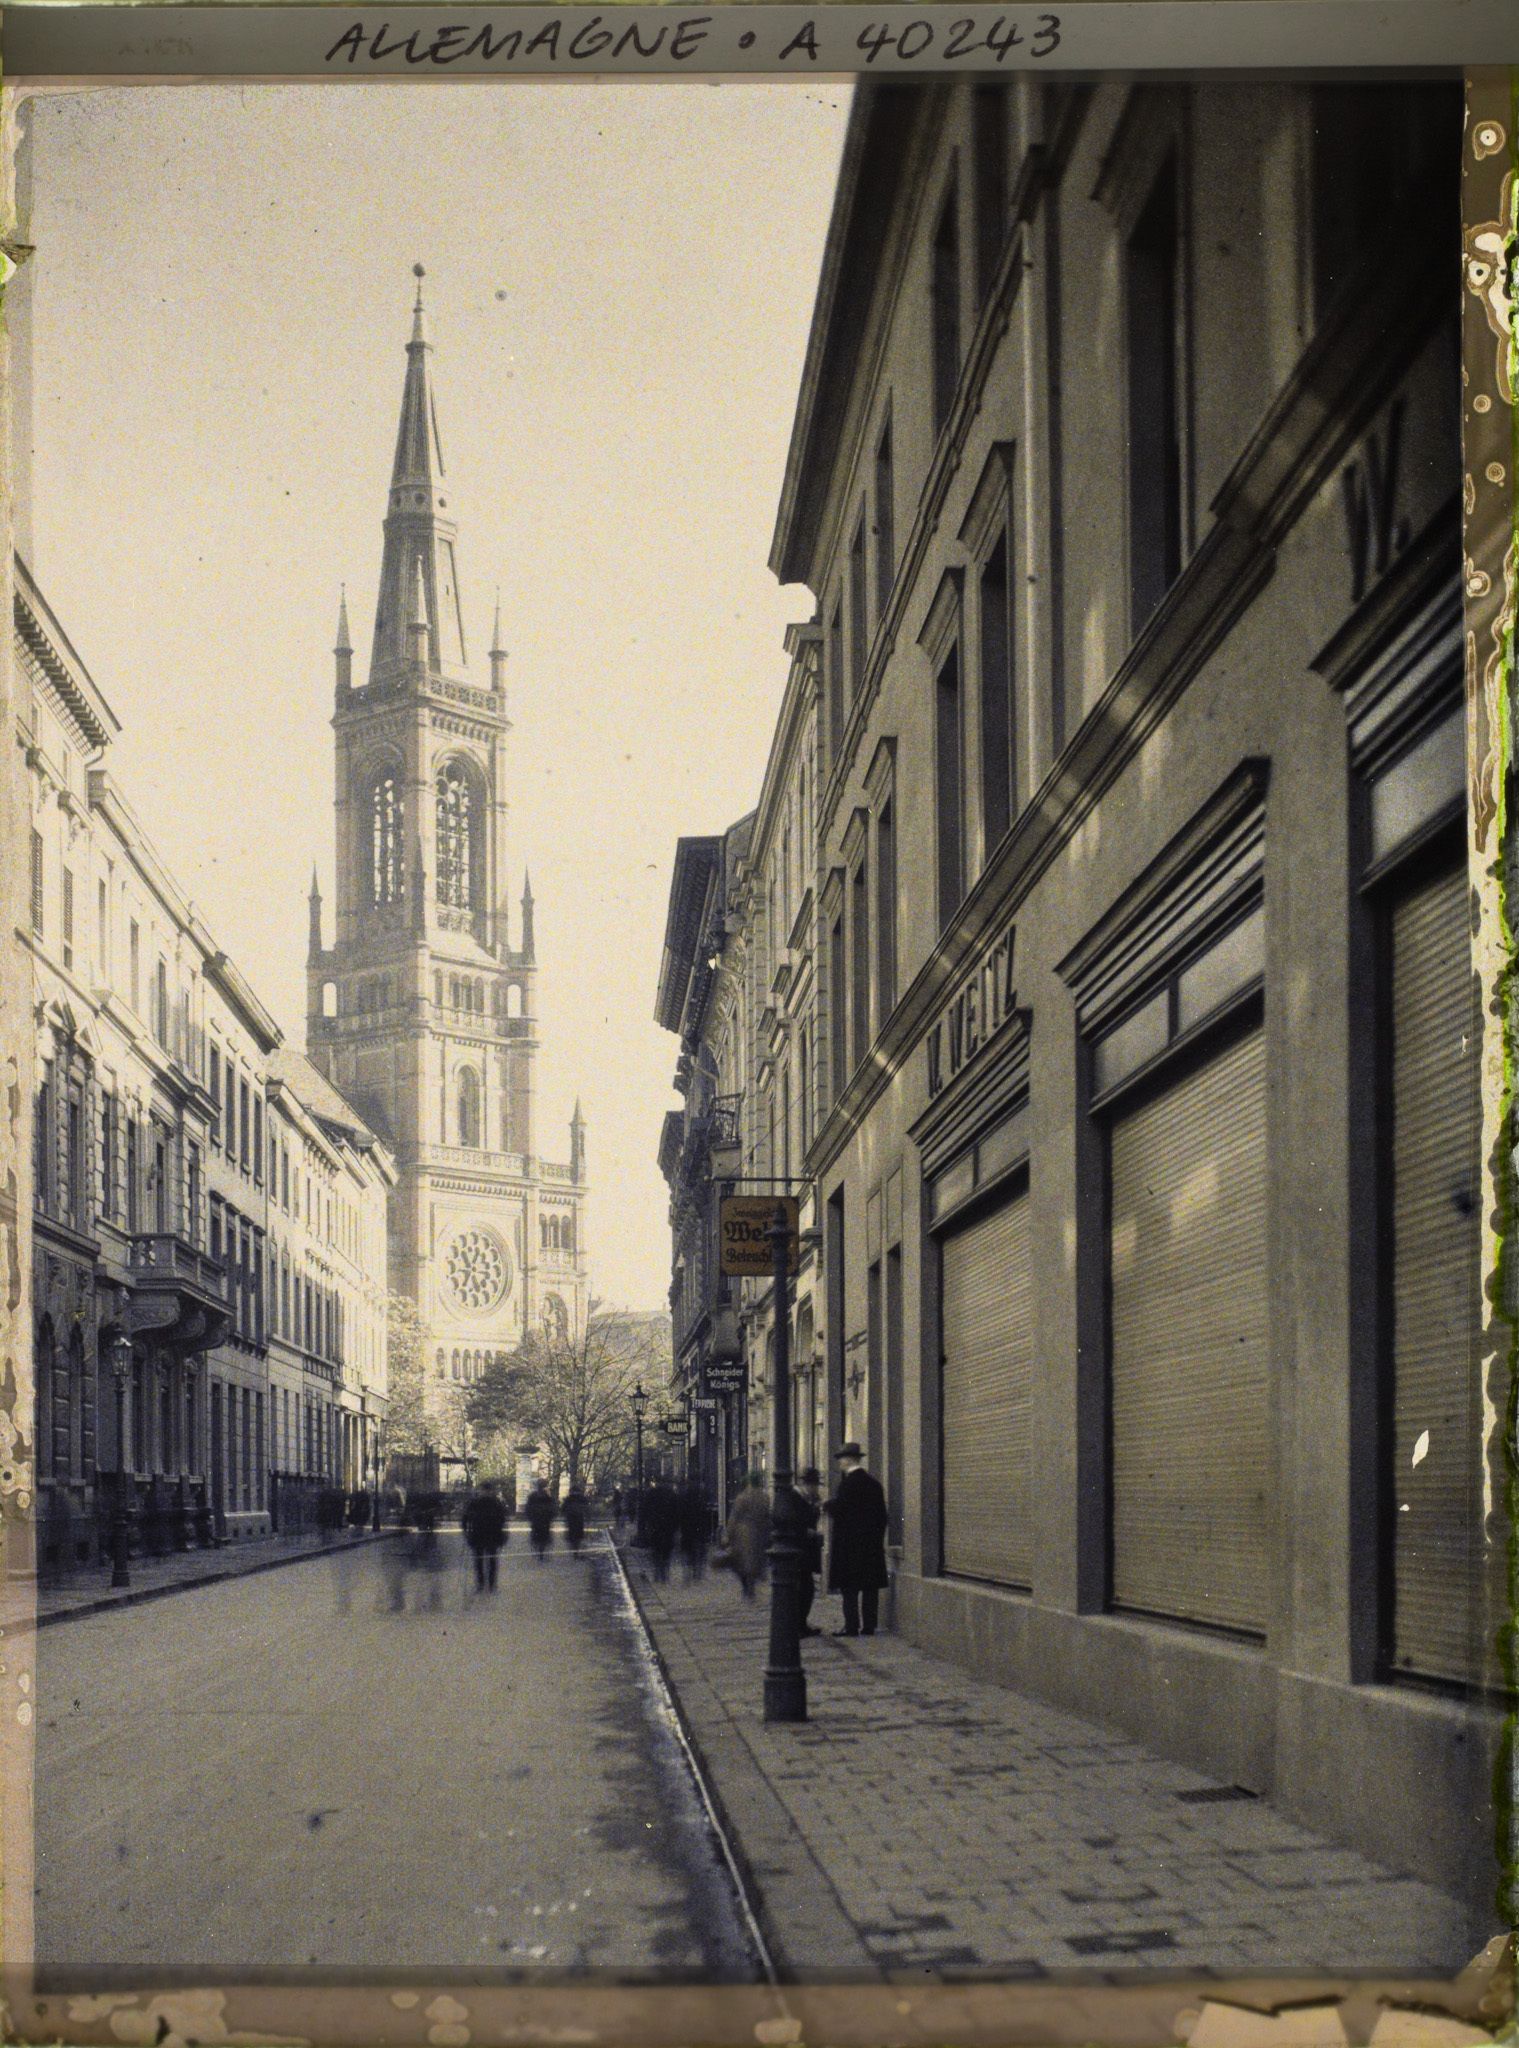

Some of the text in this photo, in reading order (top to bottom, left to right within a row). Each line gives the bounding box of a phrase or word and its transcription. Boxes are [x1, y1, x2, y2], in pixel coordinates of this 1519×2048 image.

[323, 14, 1062, 64] ALLEMAGNE A 40243
[706, 1367, 744, 1377] Schneider
[667, 1421, 688, 1433] BANK
